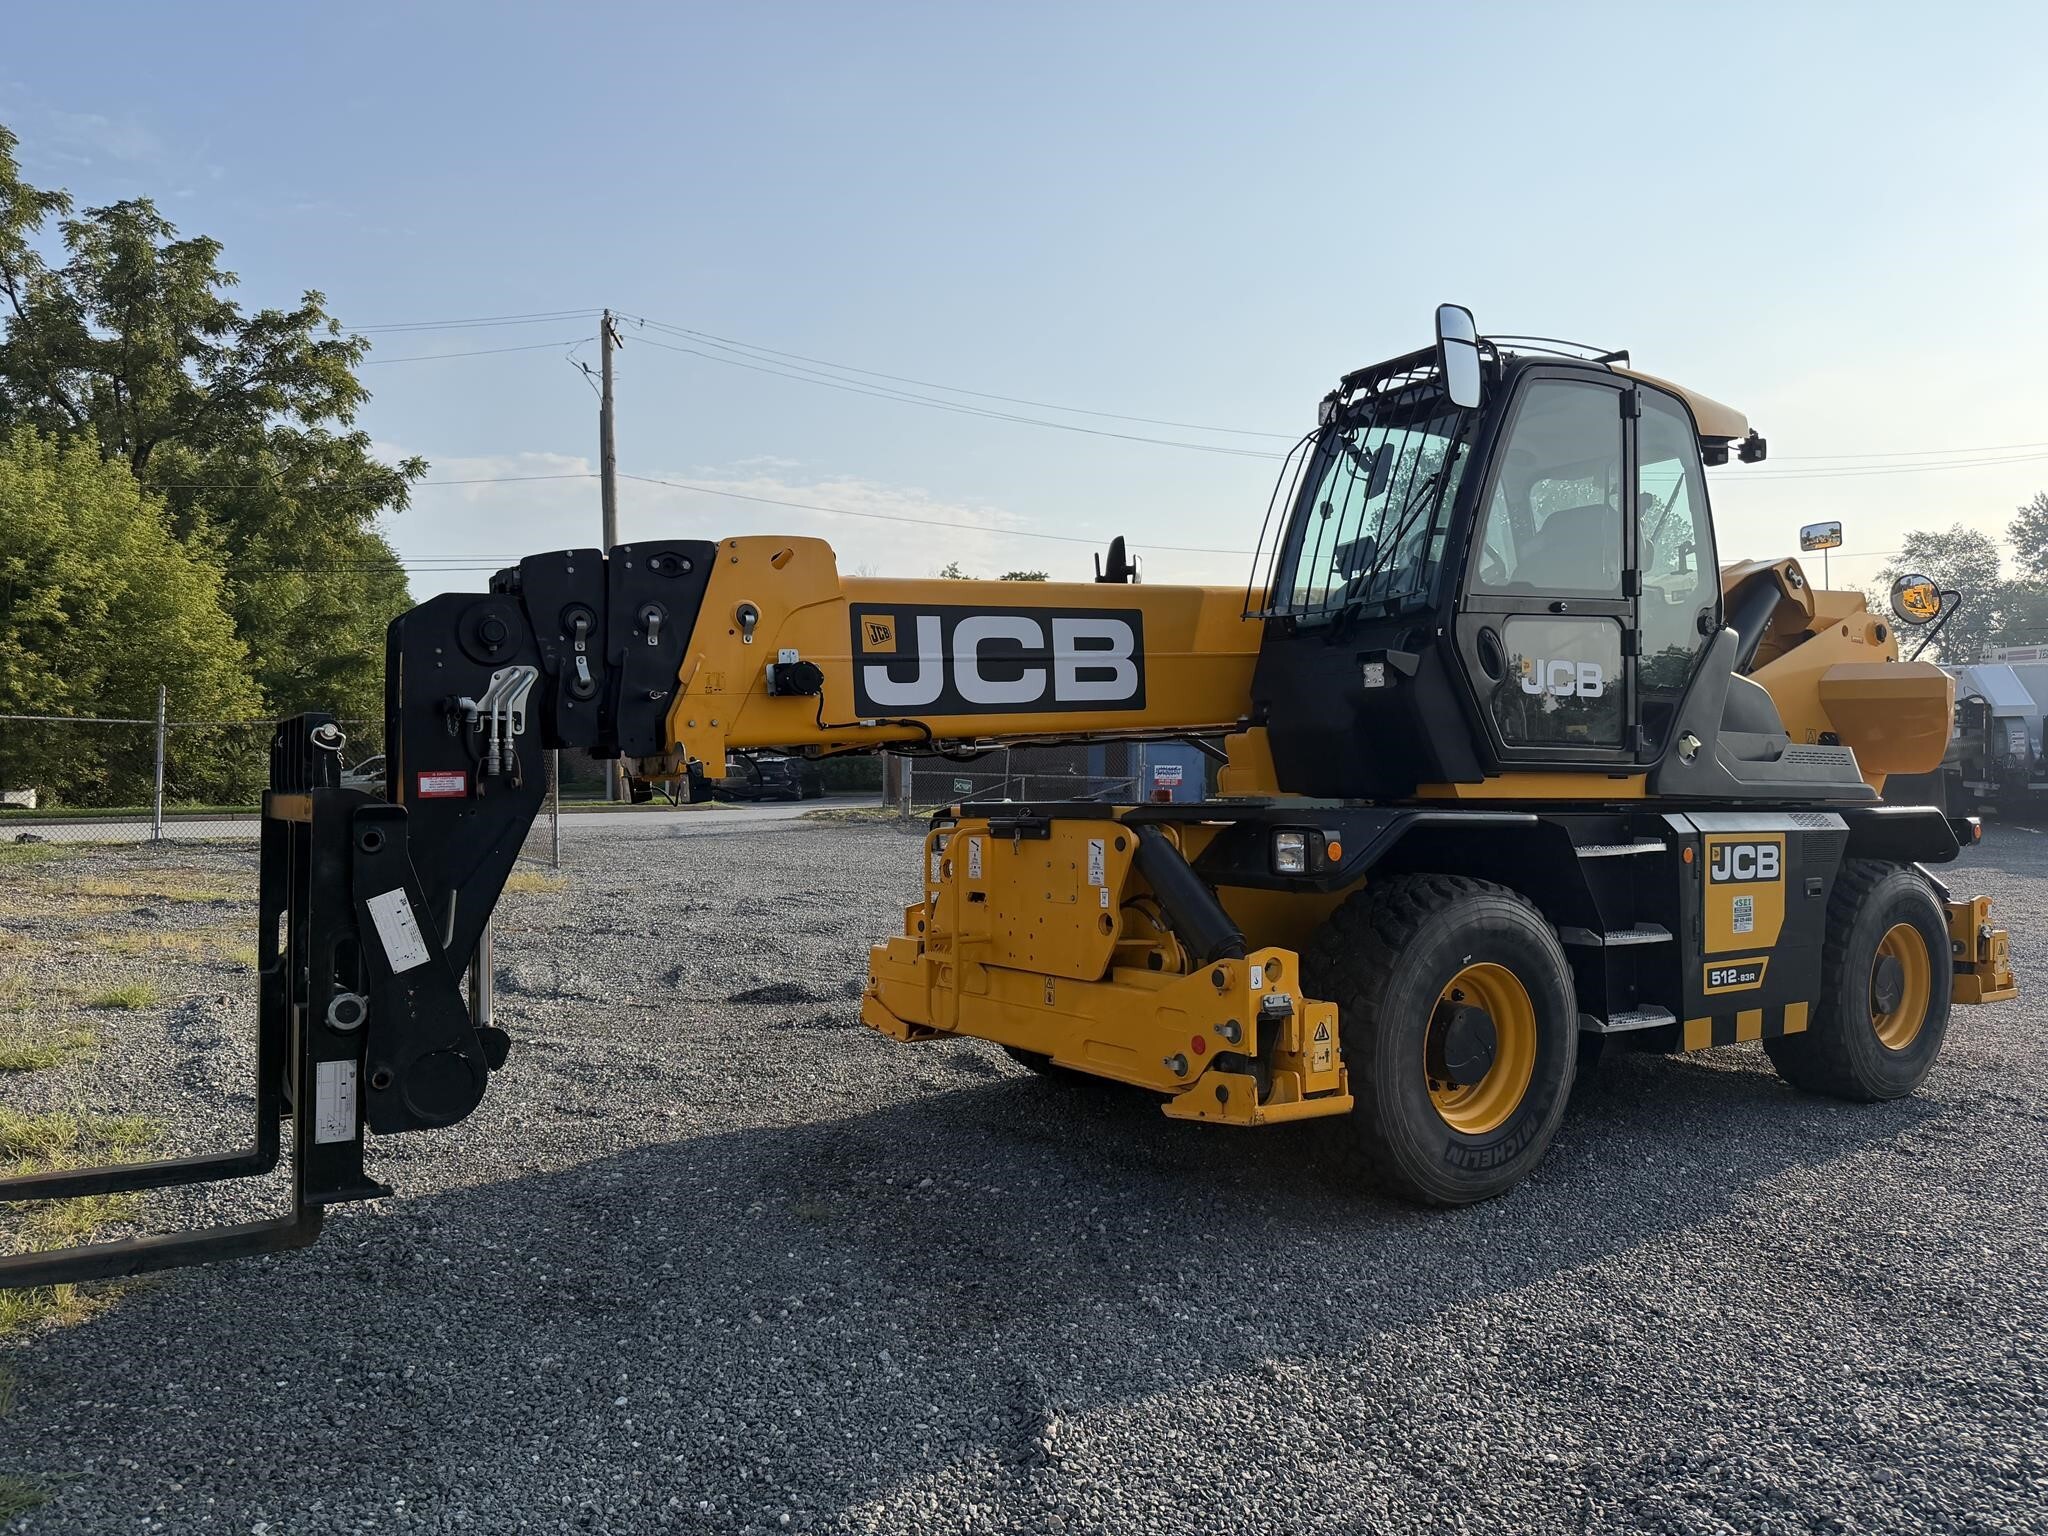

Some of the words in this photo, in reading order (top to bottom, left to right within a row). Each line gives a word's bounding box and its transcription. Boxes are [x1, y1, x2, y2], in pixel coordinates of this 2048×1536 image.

[870, 624, 890, 643] JCB
[864, 615, 1139, 706] JCB
[1521, 659, 1603, 697] JCB
[1712, 845, 1779, 880] JCB
[1447, 1112, 1540, 1169] MICHELIN
